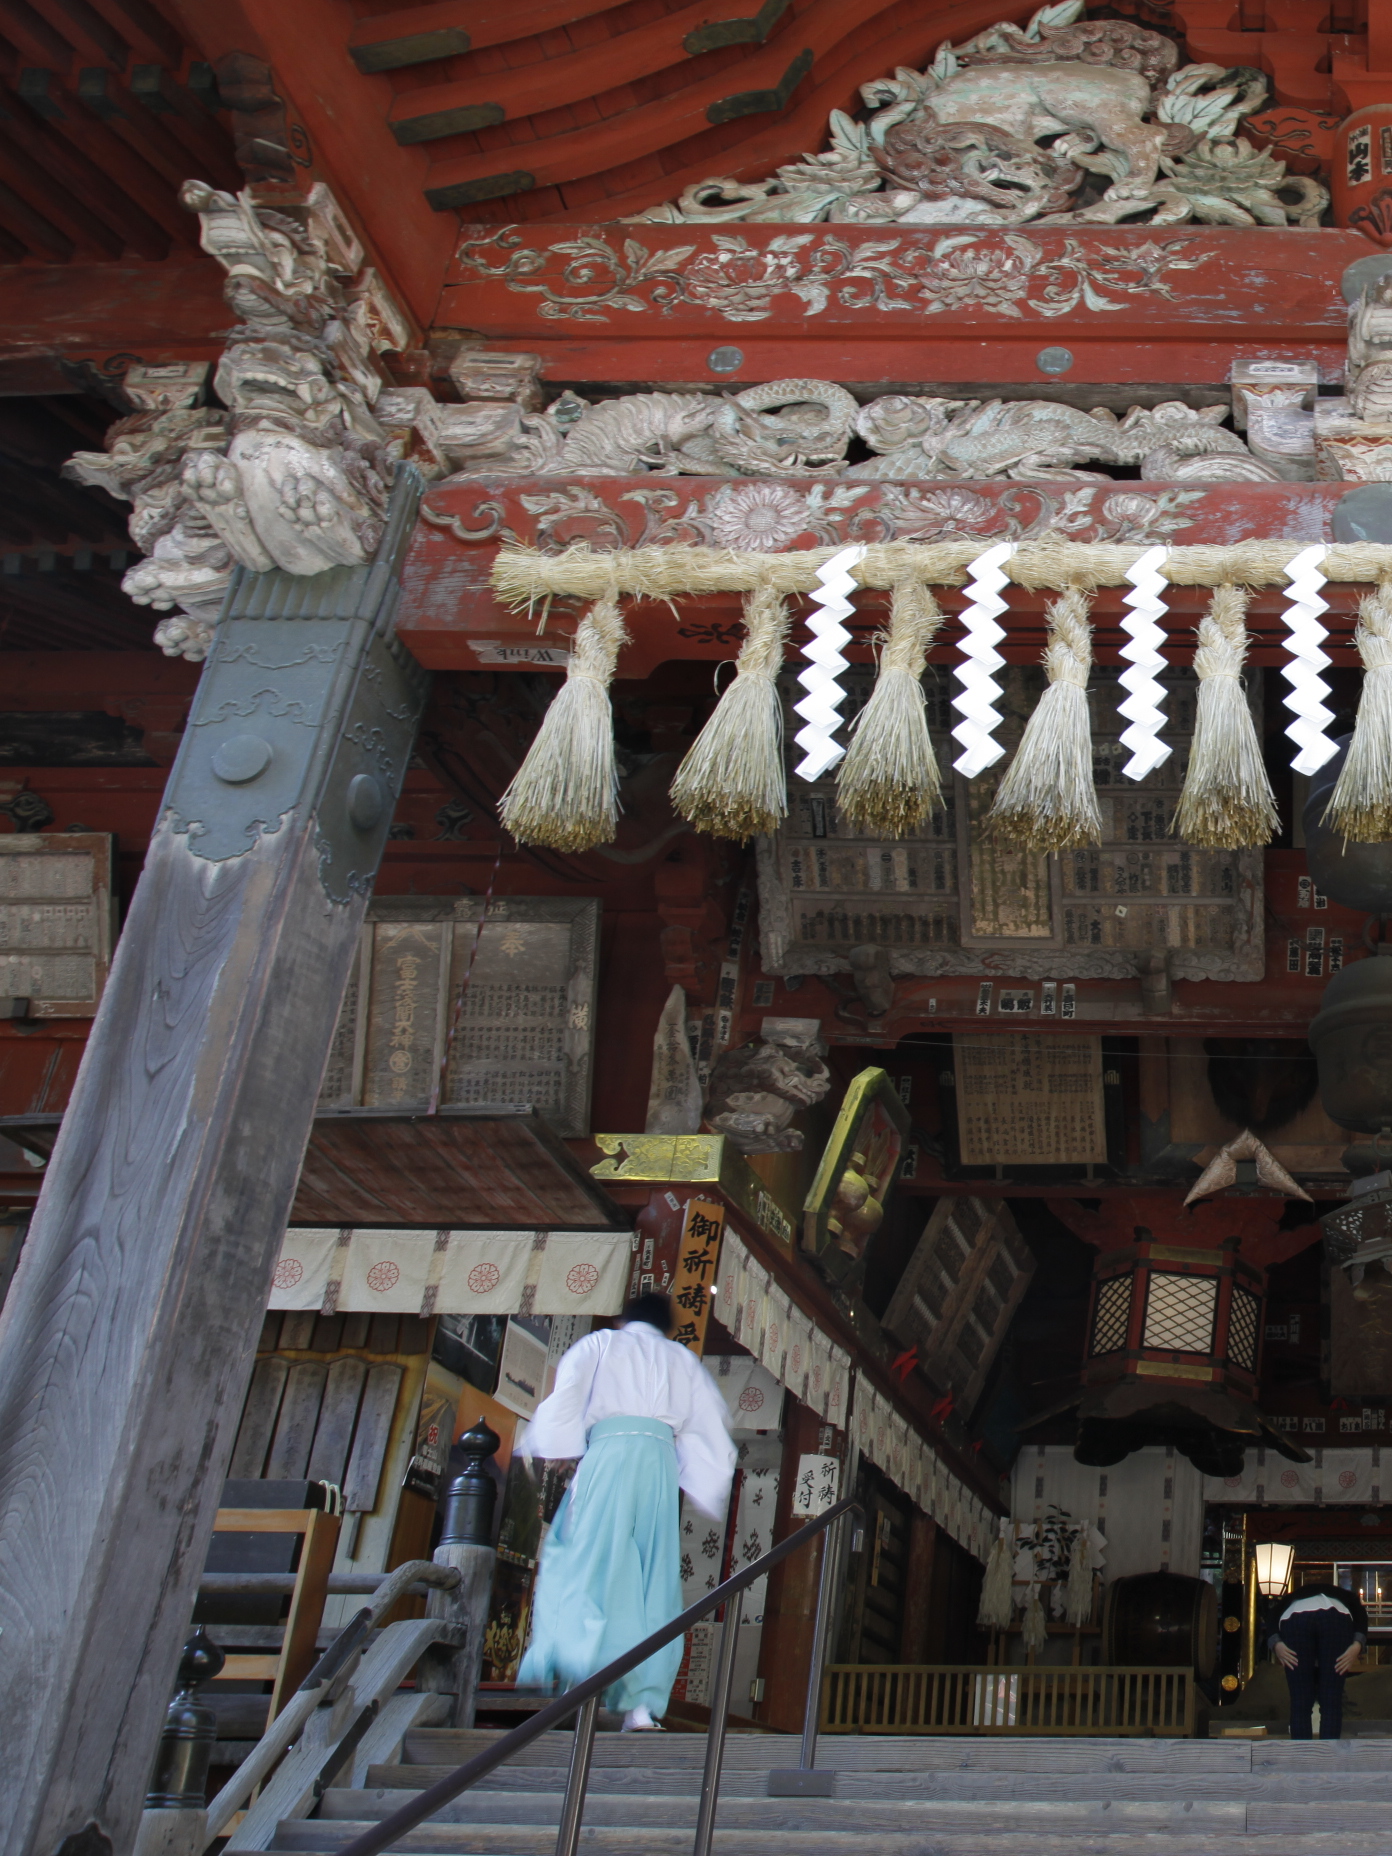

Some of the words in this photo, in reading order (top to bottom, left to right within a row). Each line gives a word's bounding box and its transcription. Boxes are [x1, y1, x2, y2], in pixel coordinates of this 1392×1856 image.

[1350, 142, 1369, 182] 山本
[495, 648, 554, 661] Wink
[500, 932, 526, 963] 奉
[427, 1423, 440, 1446] 祝
[798, 1469, 815, 1510] 受付
[819, 1460, 838, 1506] 祈祷
